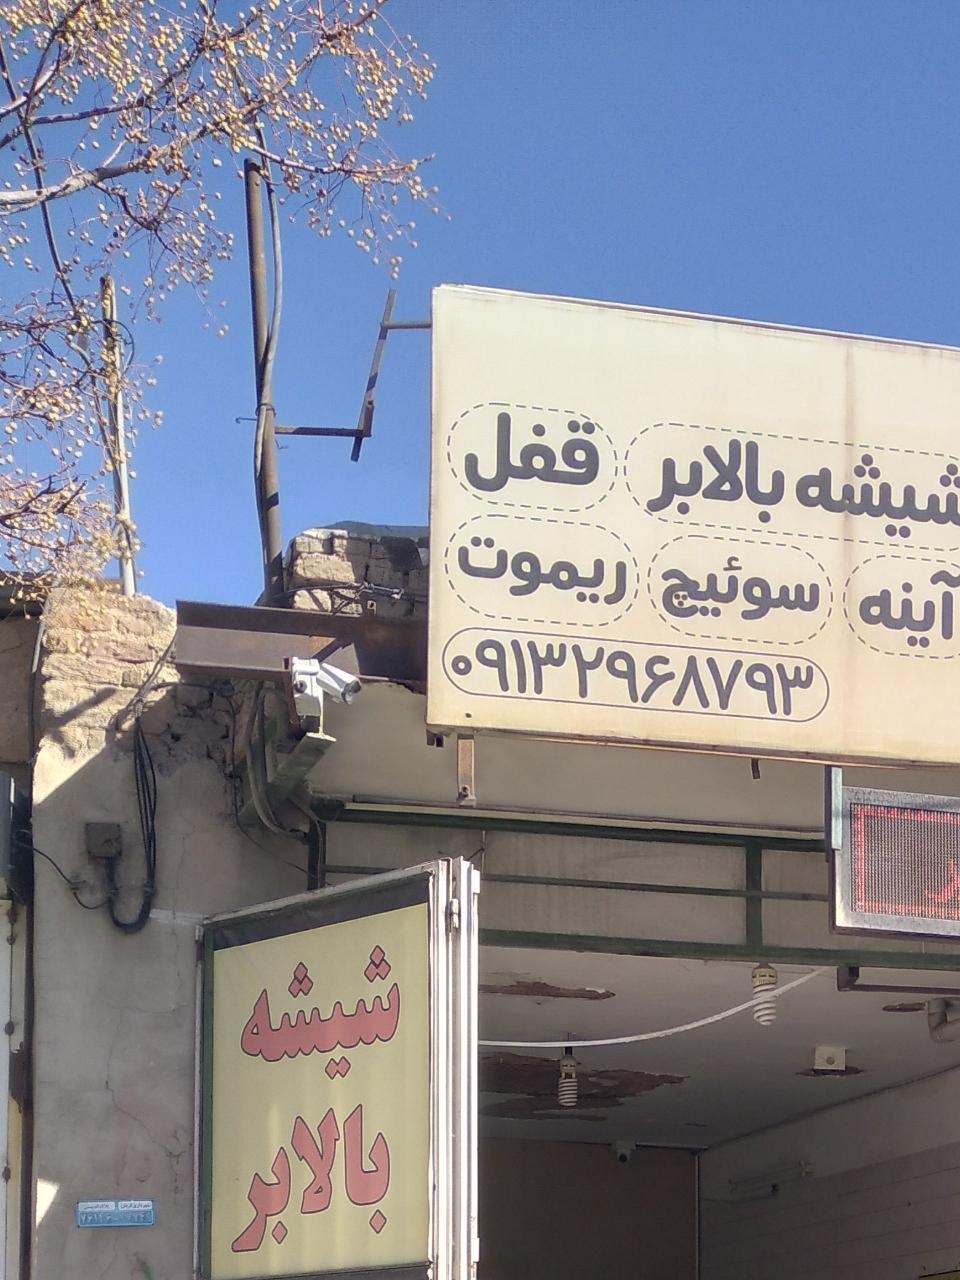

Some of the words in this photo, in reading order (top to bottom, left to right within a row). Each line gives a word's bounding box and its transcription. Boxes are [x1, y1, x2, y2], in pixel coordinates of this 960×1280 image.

[464, 412, 600, 493] قفل
[647, 439, 785, 523] بالابر
[457, 536, 627, 606] ریموت
[661, 556, 820, 621] سوئیچ
[451, 637, 814, 716] ۰۹۱۳۲۹۶۸۷۹۳
[240, 945, 401, 1079] شیشه
[231, 1103, 391, 1253] بالابر
